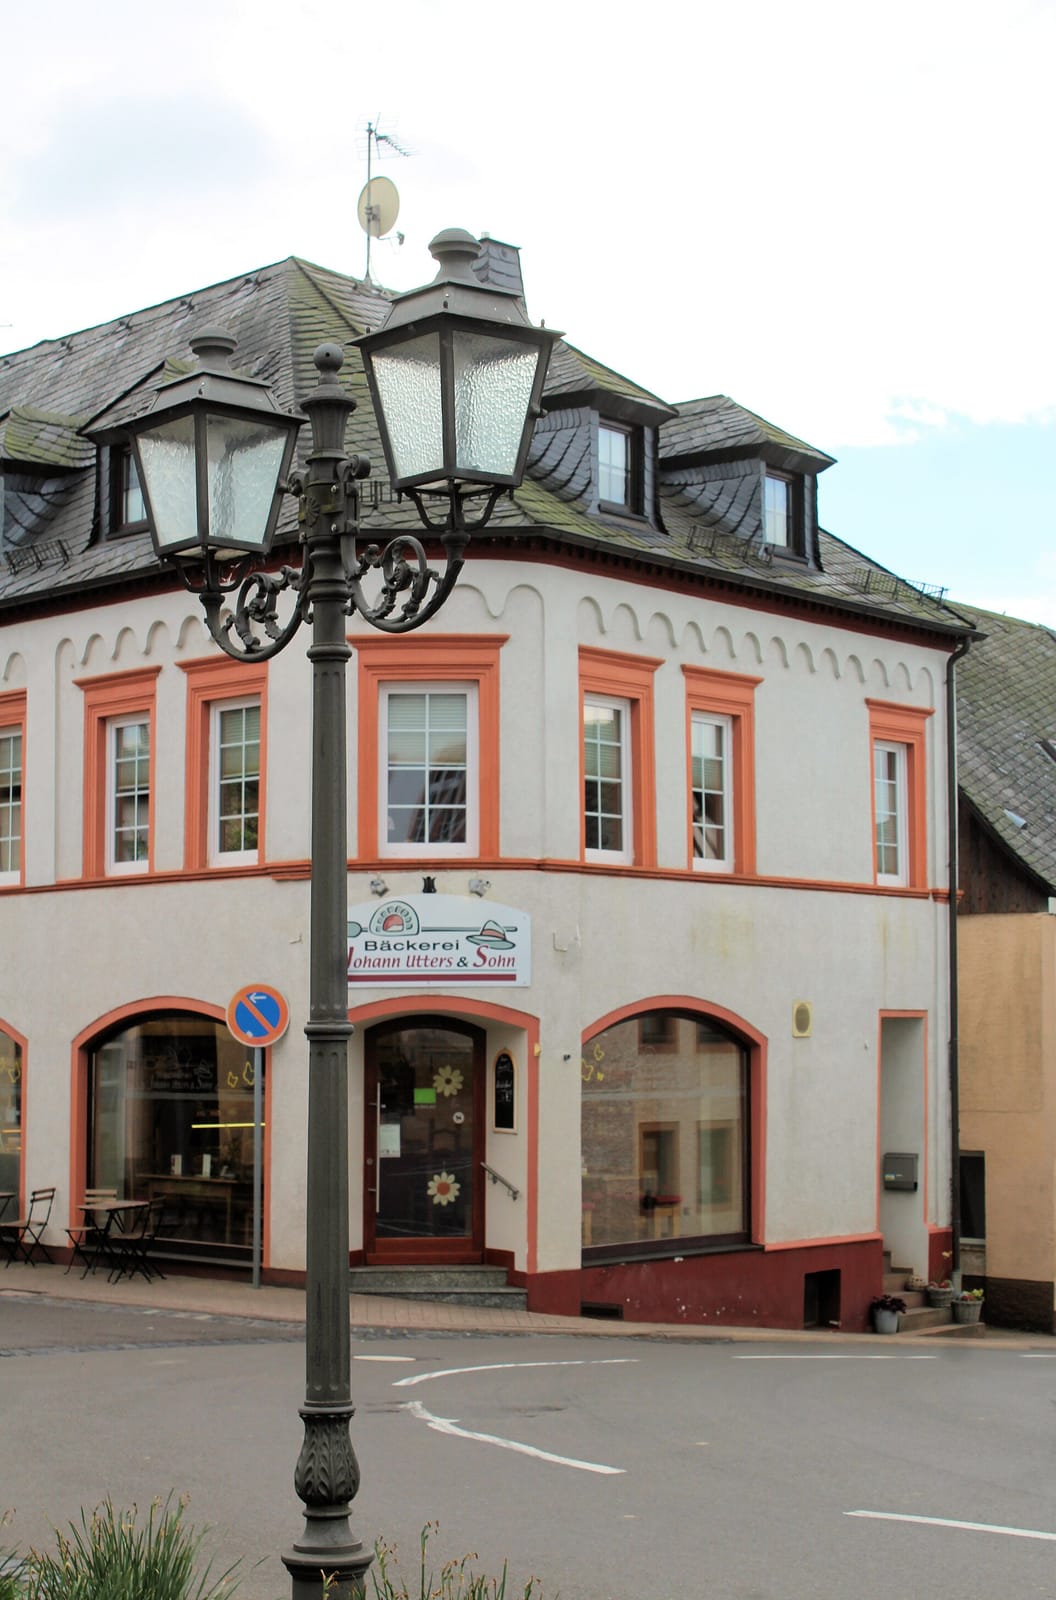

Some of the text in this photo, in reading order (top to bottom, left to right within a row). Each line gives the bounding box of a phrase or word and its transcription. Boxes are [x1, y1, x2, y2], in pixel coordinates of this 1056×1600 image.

[364, 939, 459, 951] Bäckerei
[406, 954, 453, 968] Utters
[456, 956, 469, 968] &
[473, 944, 515, 968] Sohn
